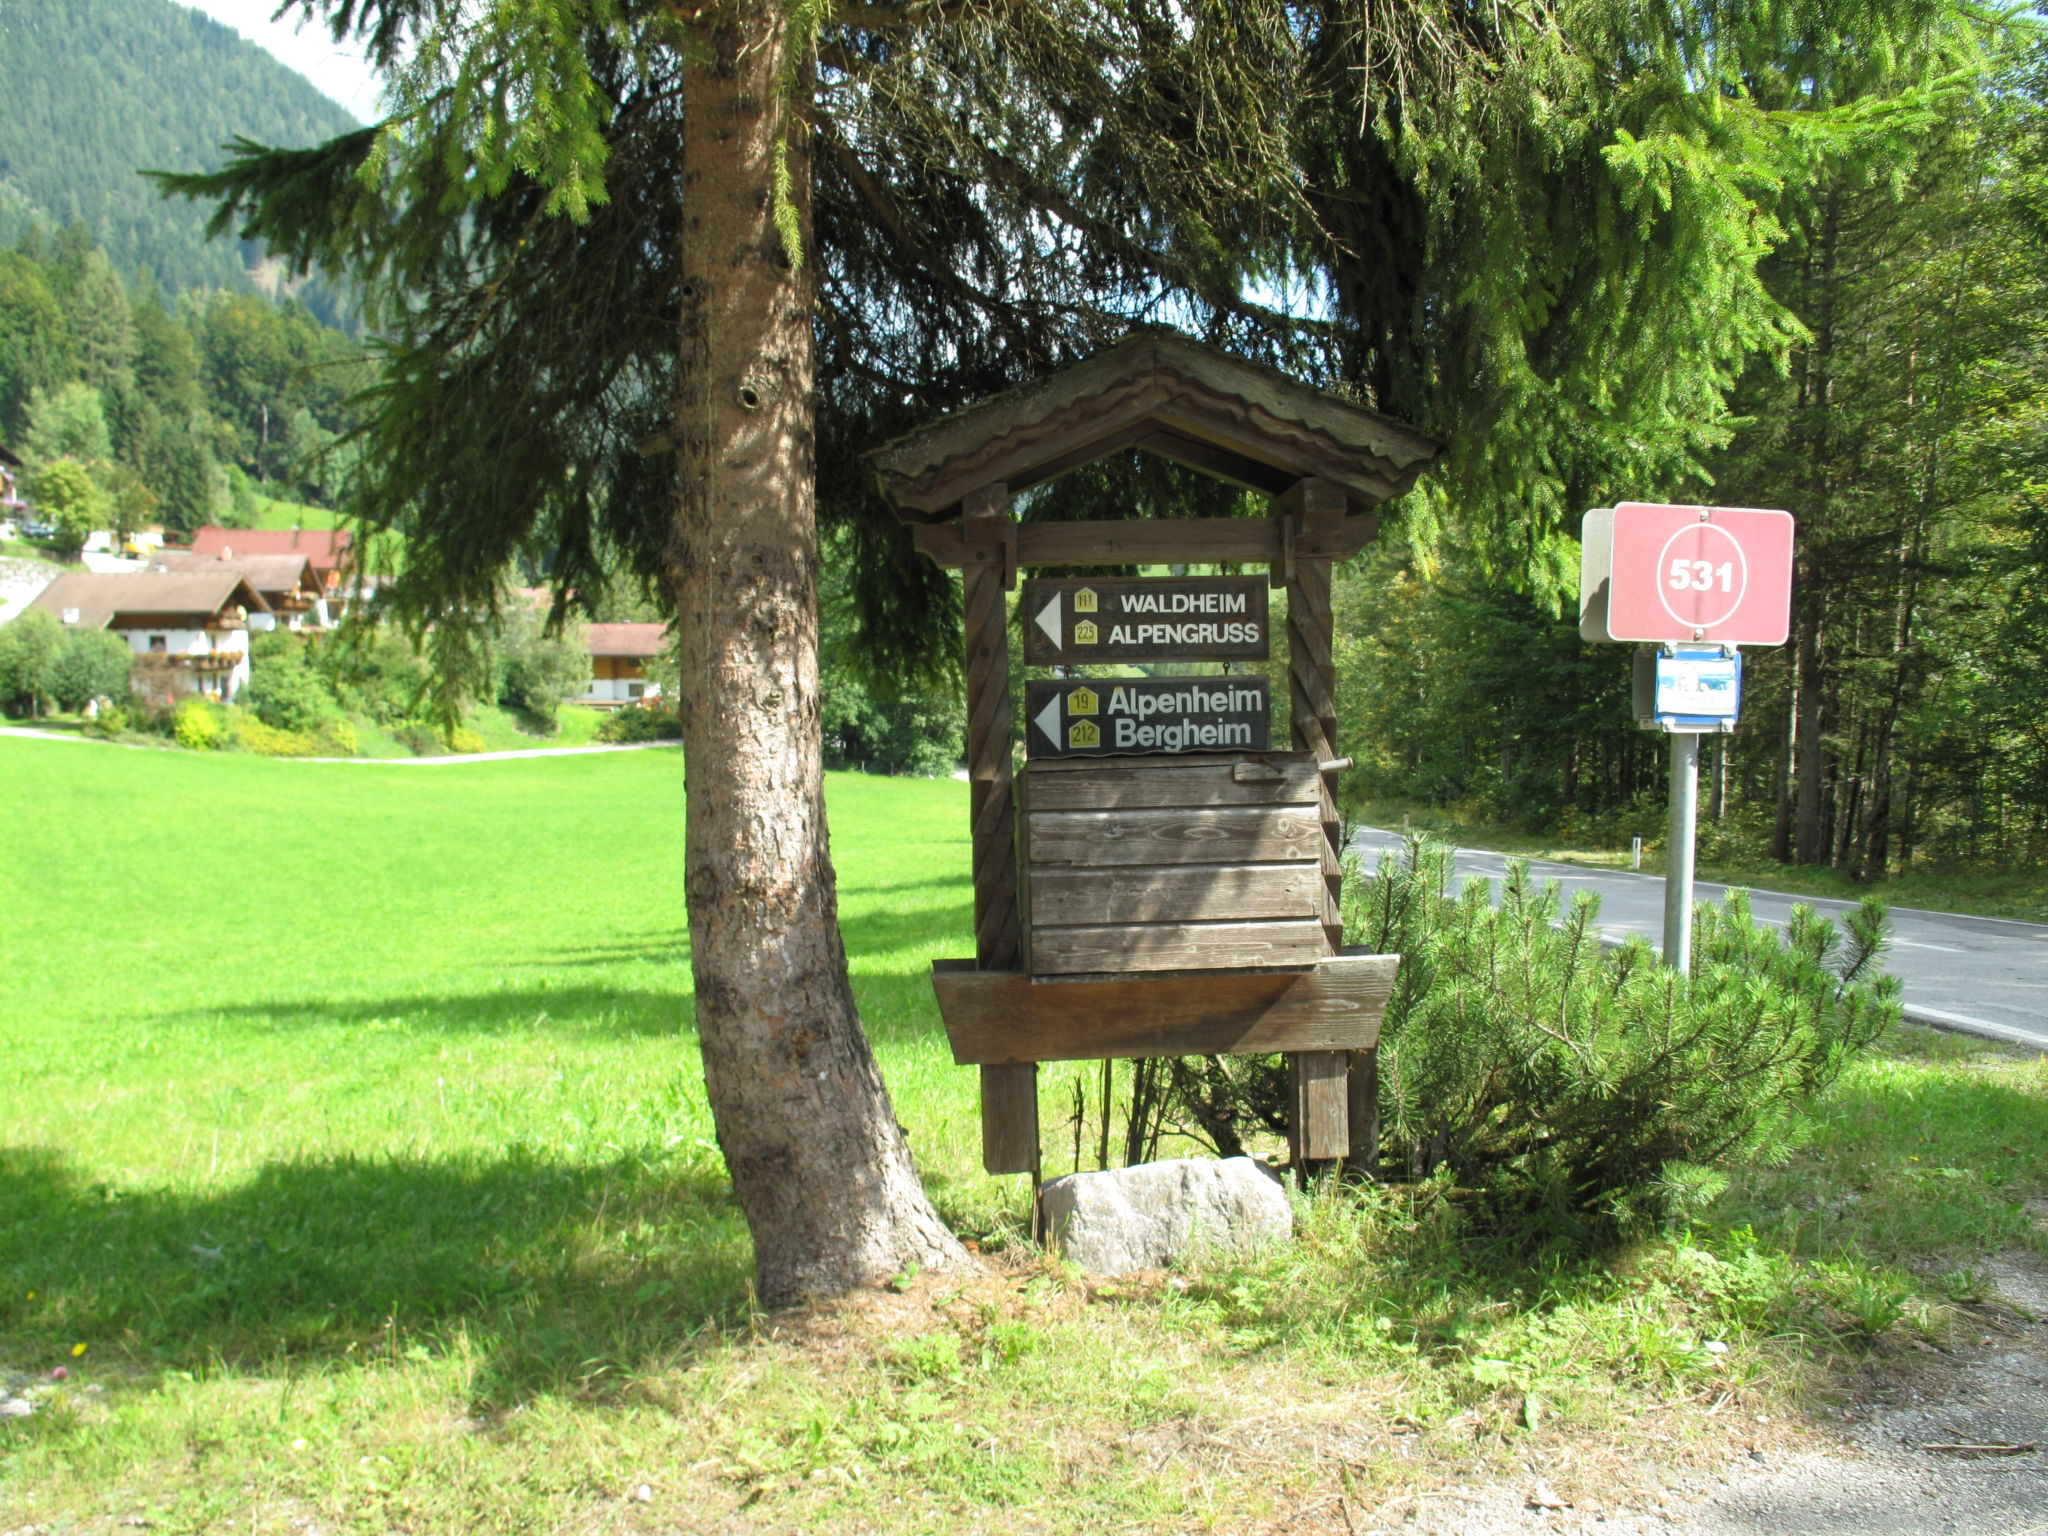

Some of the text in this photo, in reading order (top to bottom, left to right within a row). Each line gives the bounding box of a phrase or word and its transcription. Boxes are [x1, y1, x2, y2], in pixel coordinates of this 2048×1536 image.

[1668, 558, 1733, 593] 531
[1078, 593, 1246, 614] 111 WALDHEIM
[1078, 623, 1260, 645] 225 ALPENGRUSS
[1073, 685, 1262, 722] 19 Alpenheim
[1073, 717, 1251, 750] 212 Bergheim
